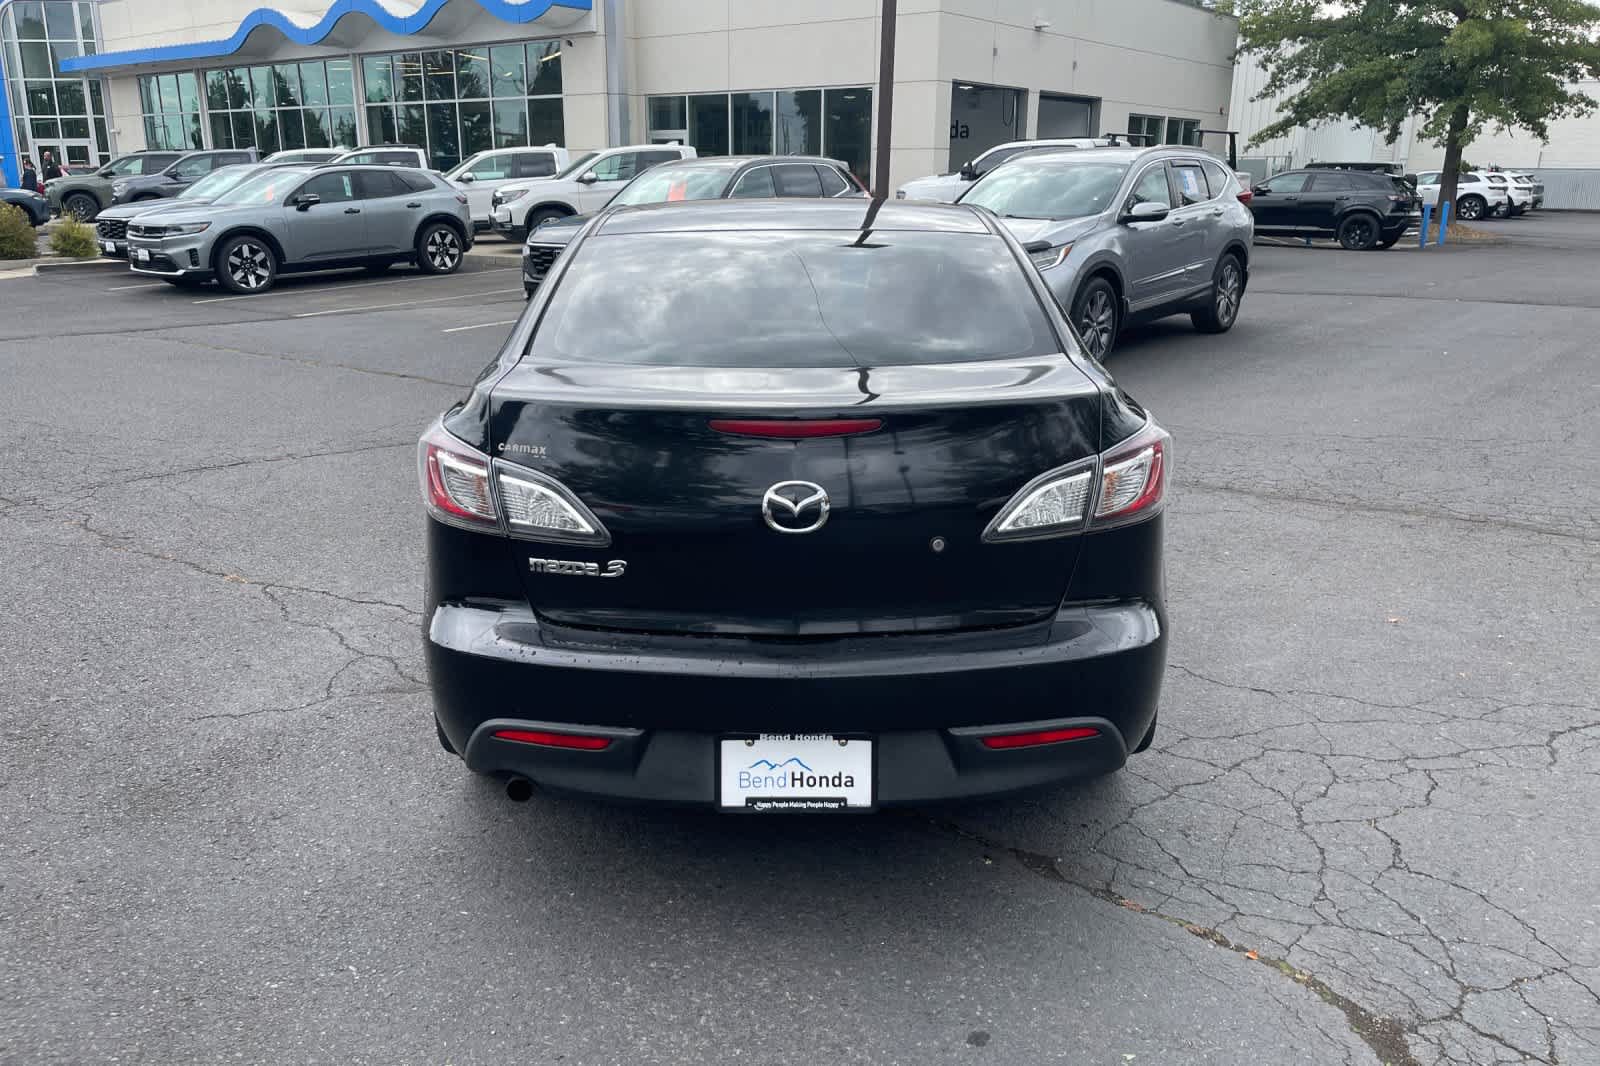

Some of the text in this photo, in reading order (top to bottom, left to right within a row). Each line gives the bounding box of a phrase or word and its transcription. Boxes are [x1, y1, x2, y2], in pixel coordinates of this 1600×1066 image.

[739, 771, 855, 789] Bend Honda
[789, 801, 807, 809] Making
[807, 801, 823, 809] People
